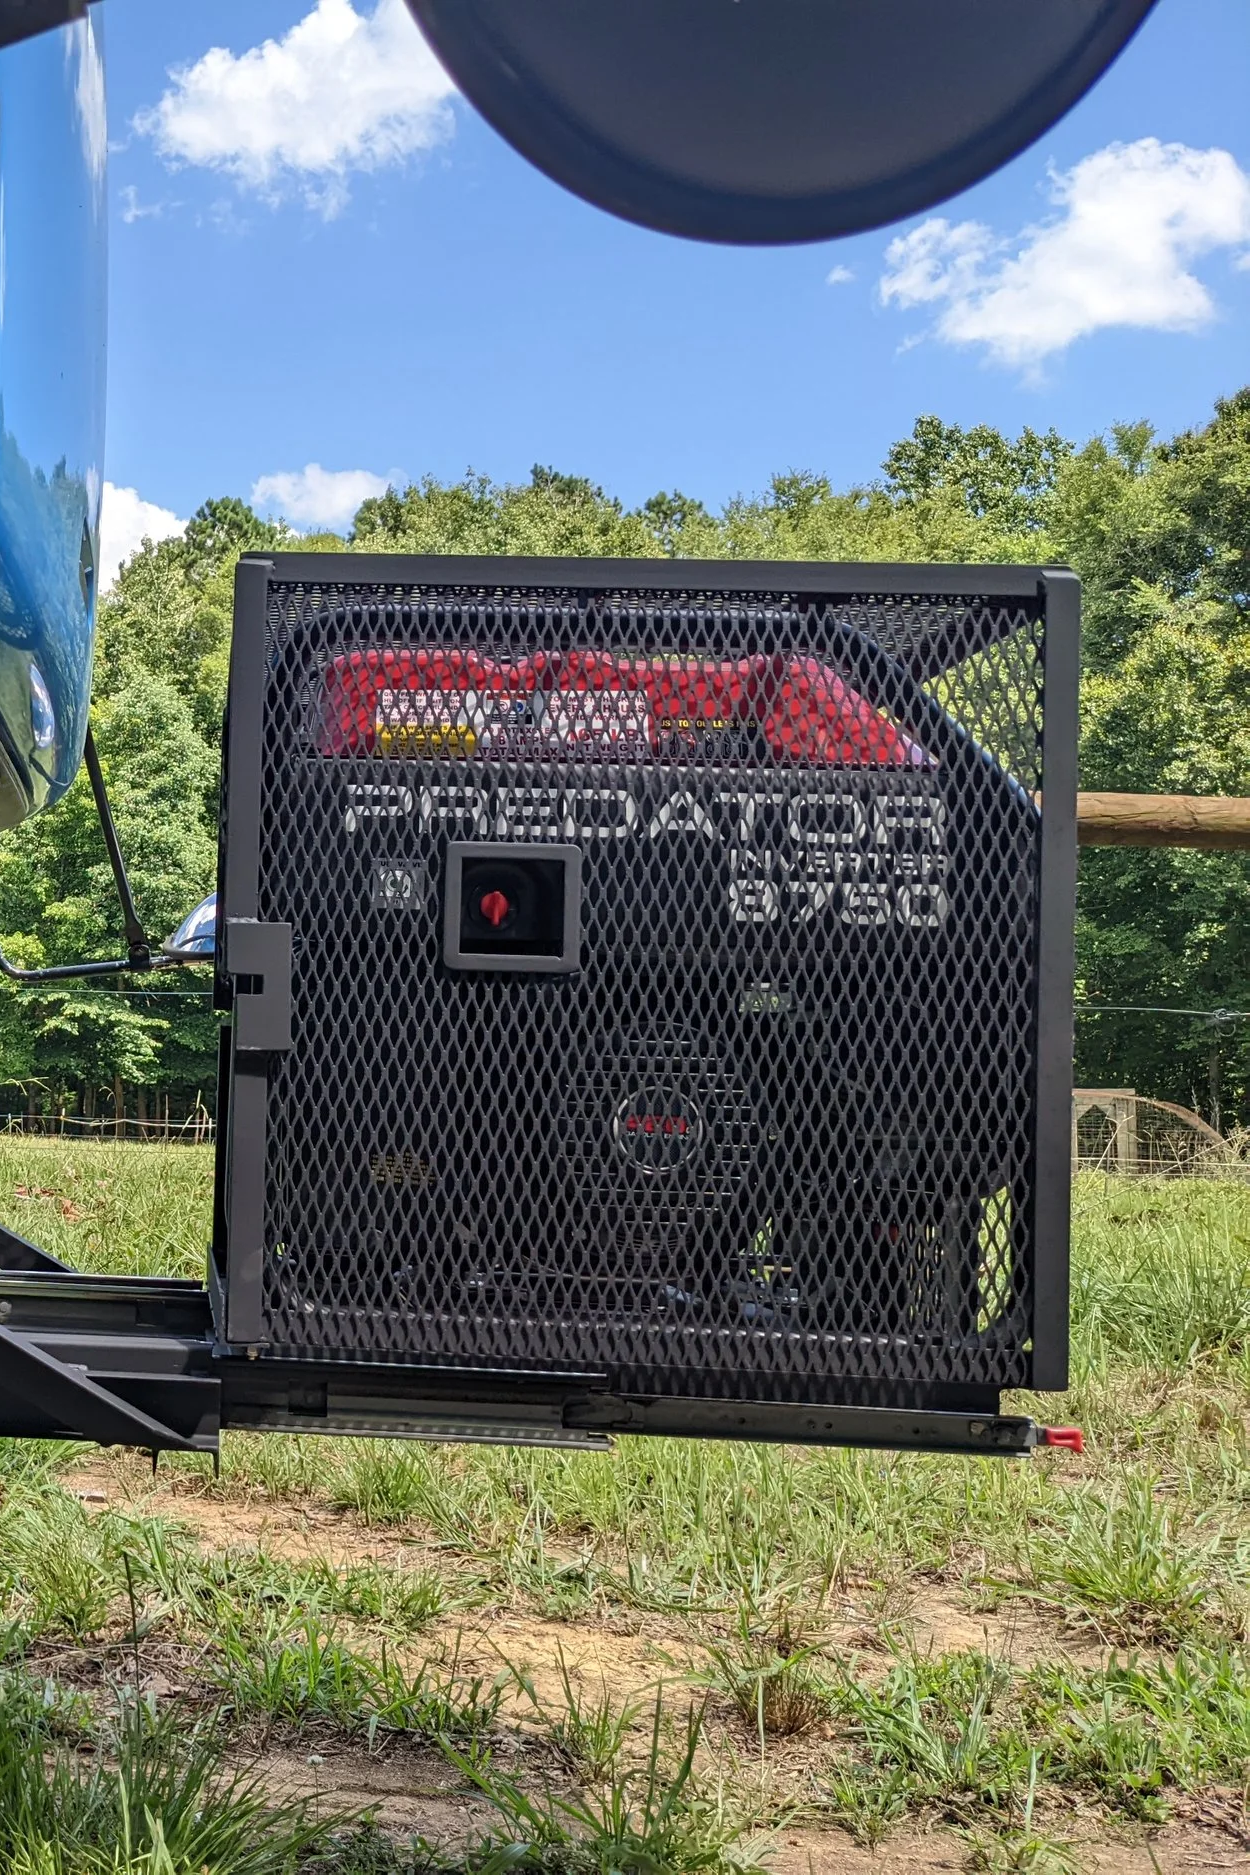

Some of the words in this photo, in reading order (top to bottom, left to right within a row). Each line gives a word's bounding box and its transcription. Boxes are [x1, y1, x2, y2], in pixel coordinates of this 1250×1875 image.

[346, 785, 946, 846] PREDATOR
[730, 849, 948, 876] INVERTER
[729, 879, 948, 927] 8750
